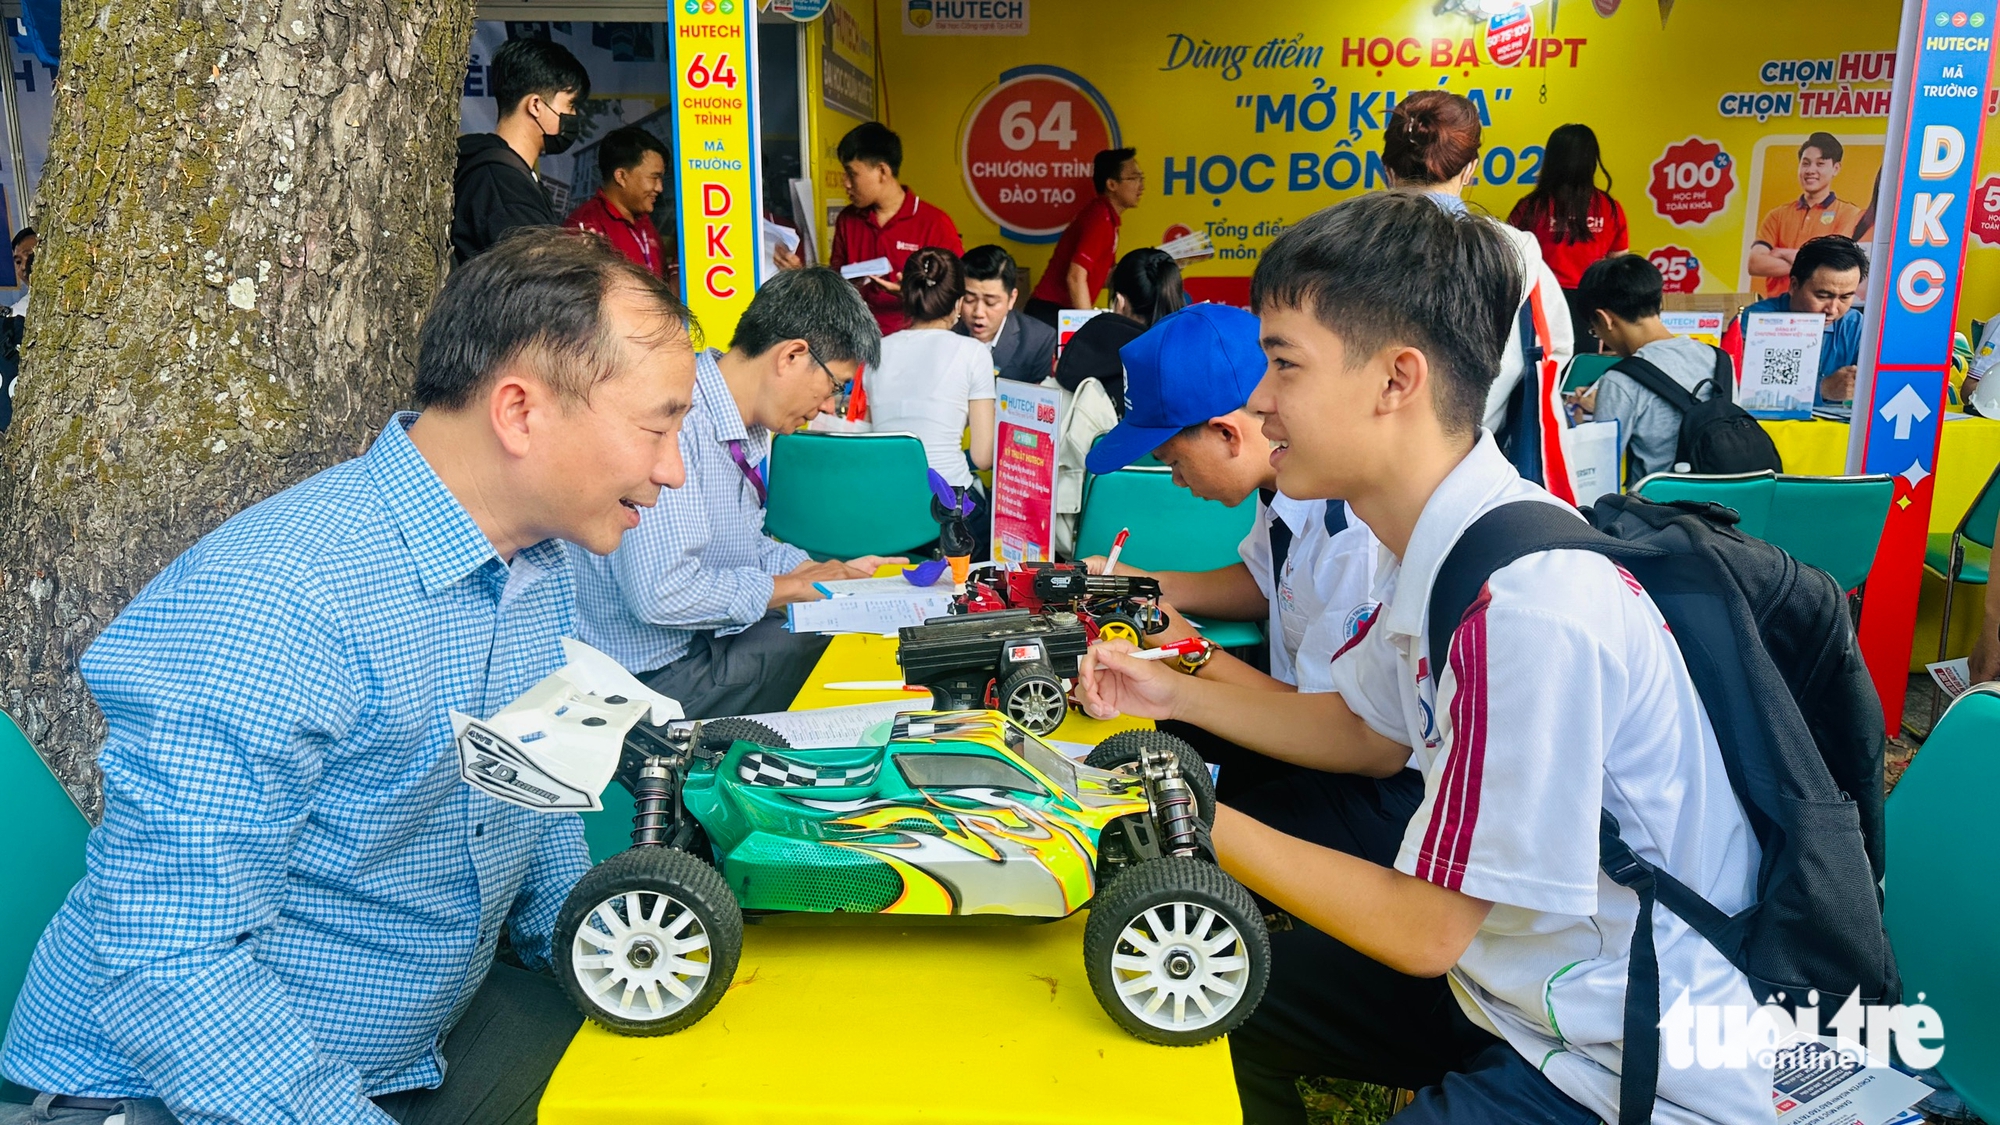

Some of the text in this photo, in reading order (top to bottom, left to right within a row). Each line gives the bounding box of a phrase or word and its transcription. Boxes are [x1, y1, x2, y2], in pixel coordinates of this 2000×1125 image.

[936, 1, 1023, 19] HUTECH
[680, 25, 740, 38] HUTECH
[1926, 36, 1990, 52] HUTECH
[1158, 33, 1587, 81] Dùng điểm HỌC BẠ HPT
[687, 54, 737, 89] 64
[1761, 52, 1897, 88] CHỌN HUT
[1942, 64, 1964, 79] MÃ
[1923, 82, 1979, 98] TRƯỜNG
[683, 97, 742, 109] CHƯƠNG
[1719, 93, 1792, 121] CHỌN
[694, 111, 732, 125] TRÌNH
[999, 100, 1078, 151] 64
[704, 138, 725, 152] MÃ
[688, 156, 742, 170] TRƯỜNG
[972, 158, 1094, 178] CHƯƠNG TRÌN
[1163, 153, 1275, 207] HỌC
[1288, 128, 1389, 192] BỔN
[999, 183, 1076, 208] ĐÀO TẠO
[1673, 190, 1707, 202] HỌC PHÍ
[1666, 199, 1713, 211] TOÀN KHÓA
[1204, 218, 1248, 240] Tổng
[1219, 244, 1257, 260] môn
[1008, 397, 1035, 413] HUTECH
[467, 753, 518, 784] ZD
